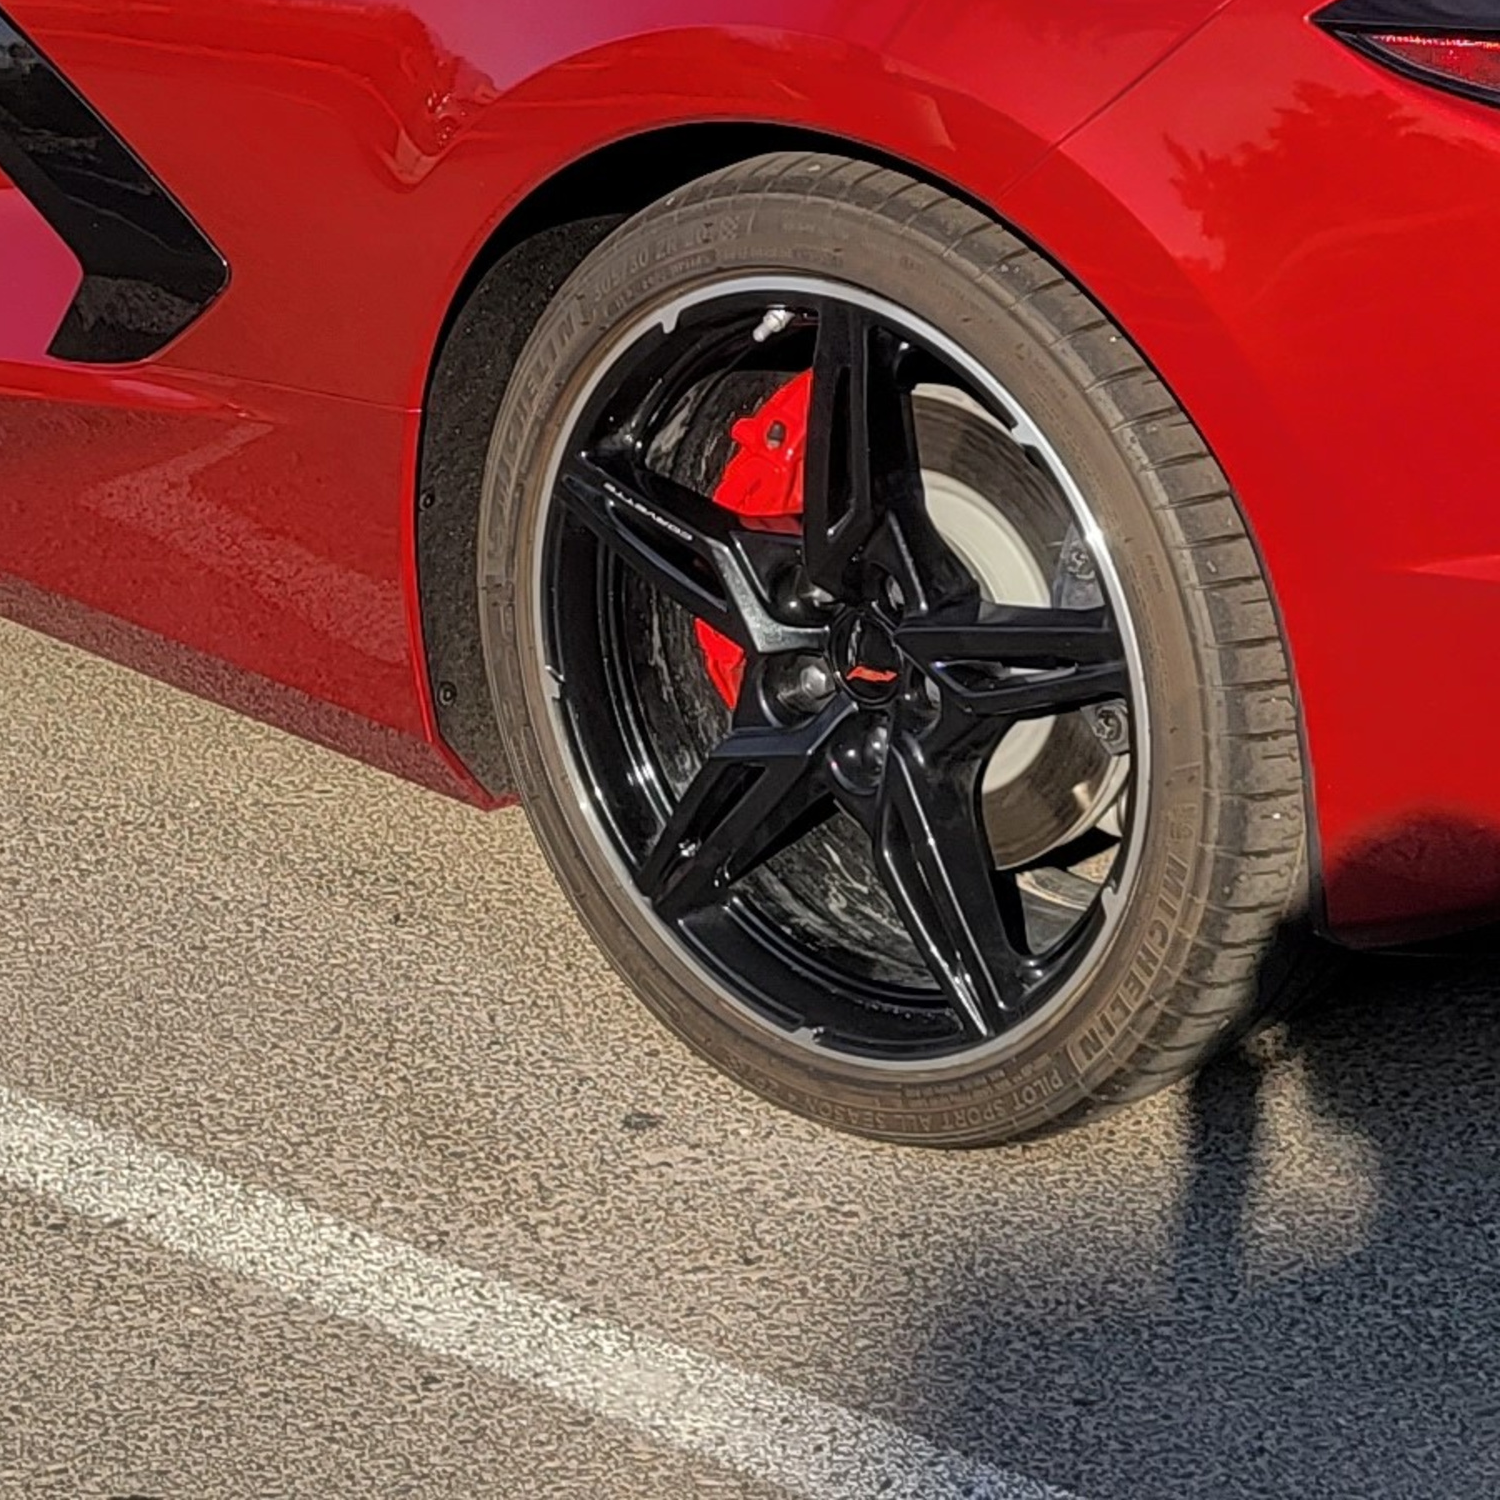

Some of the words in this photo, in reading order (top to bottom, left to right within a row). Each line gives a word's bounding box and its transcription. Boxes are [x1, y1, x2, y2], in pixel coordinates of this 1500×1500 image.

[1078, 849, 1191, 1063] MICHELIN
[1011, 1069, 1065, 1109] PILOT
[900, 1114, 931, 1132] ALL
[941, 1099, 1008, 1131] SPORT
